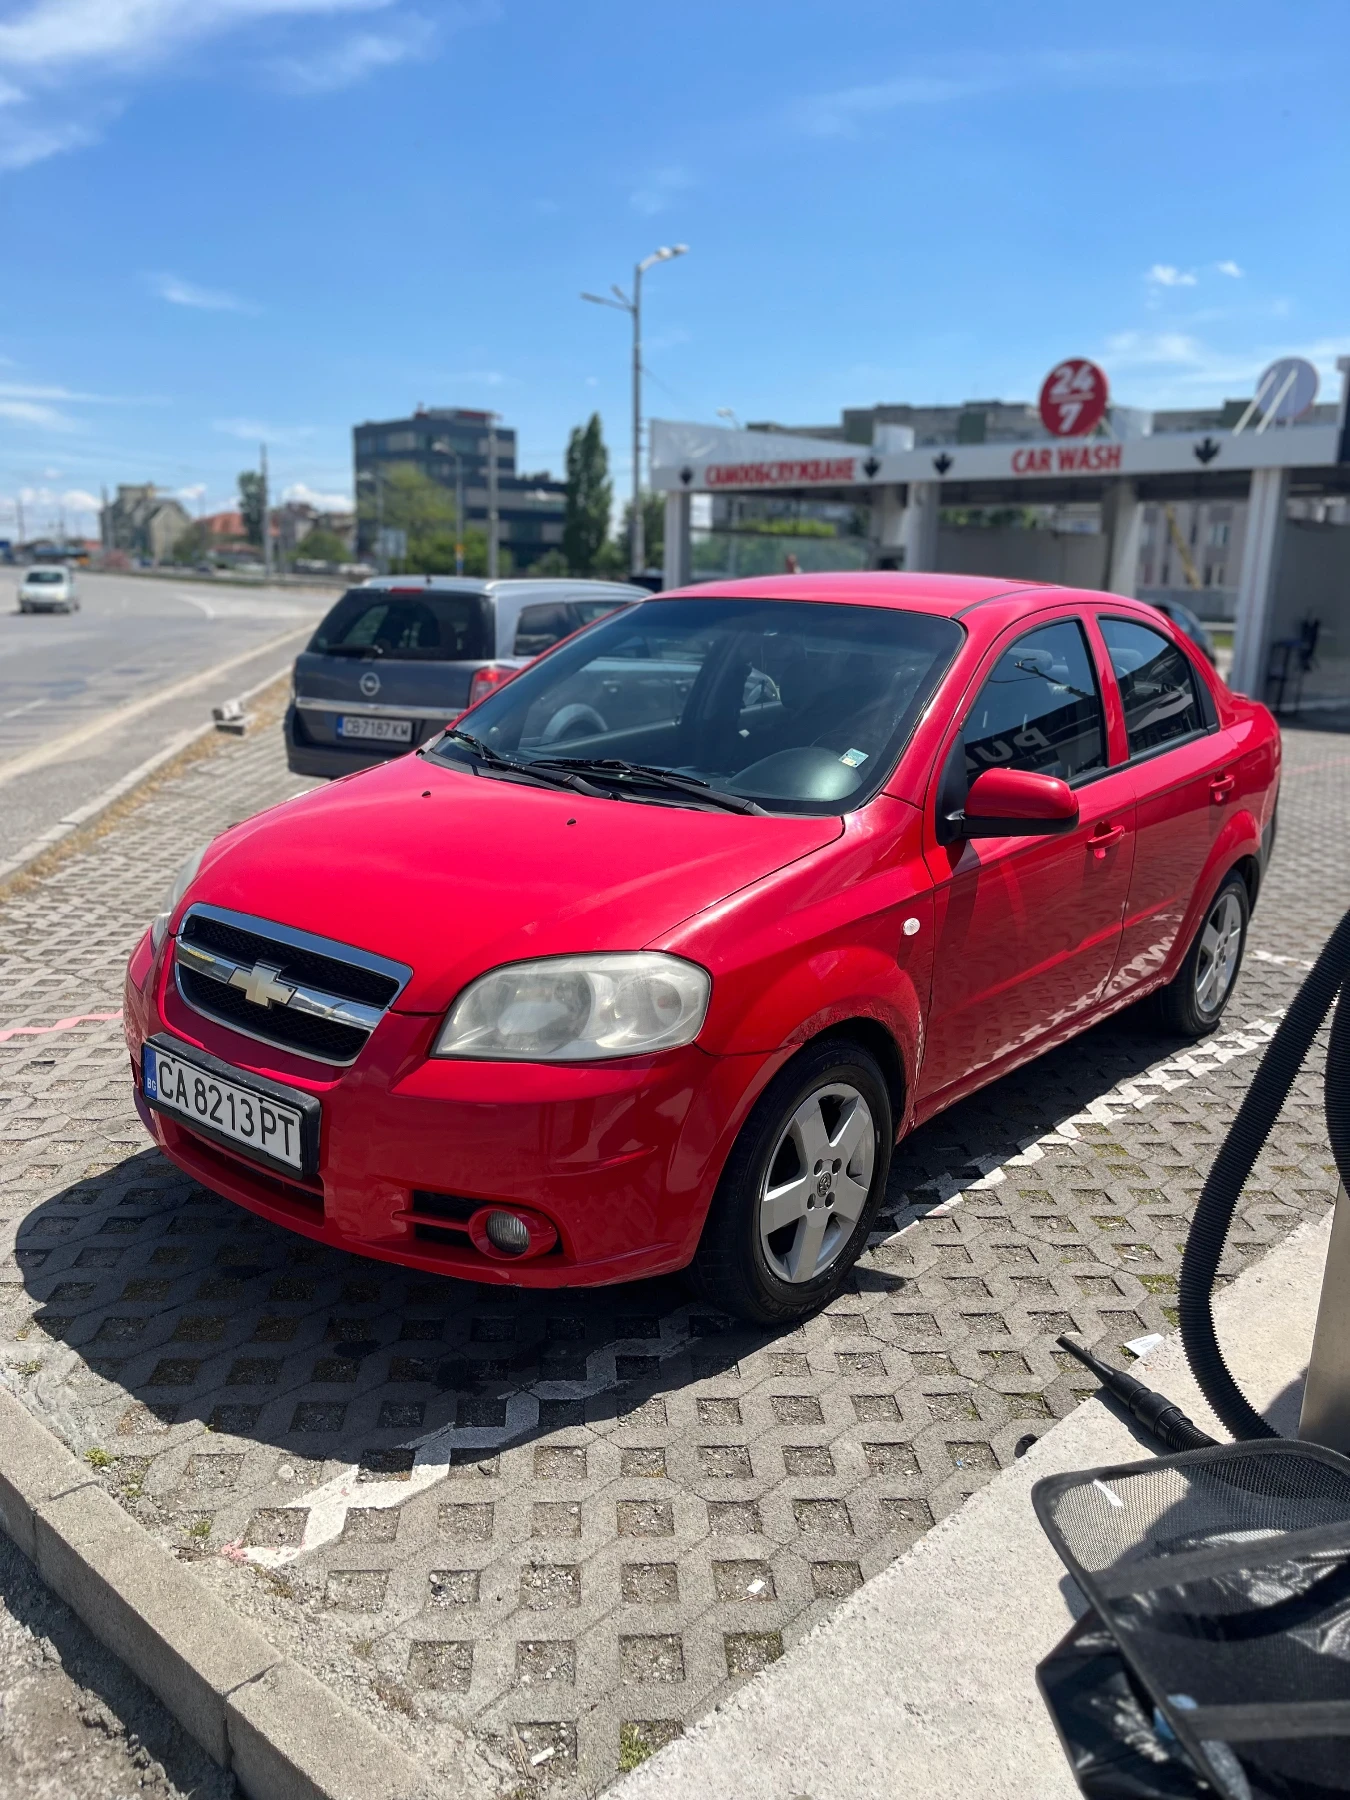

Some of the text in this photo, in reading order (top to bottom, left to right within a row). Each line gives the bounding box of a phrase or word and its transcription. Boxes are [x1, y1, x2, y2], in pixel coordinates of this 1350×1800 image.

[1050, 363, 1095, 395] 24
[1059, 402, 1083, 433] 7
[1011, 444, 1122, 473] CAR WASH
[147, 1077, 157, 1091] BG
